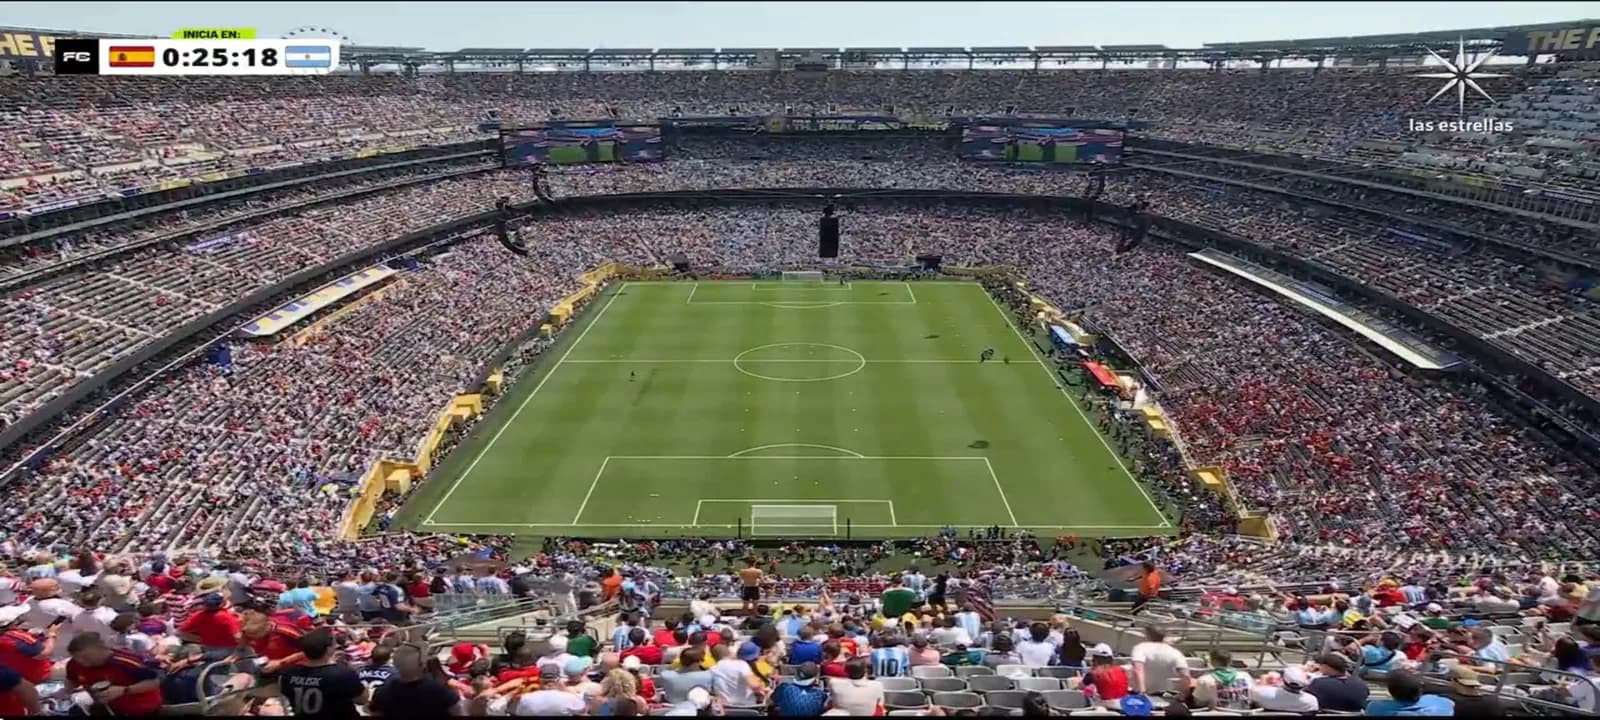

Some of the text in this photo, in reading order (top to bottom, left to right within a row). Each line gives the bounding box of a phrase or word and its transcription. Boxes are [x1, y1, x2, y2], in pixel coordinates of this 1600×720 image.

[1528, 29, 1585, 50] THE
[881, 659, 898, 677] 10
[294, 687, 324, 714] 10
